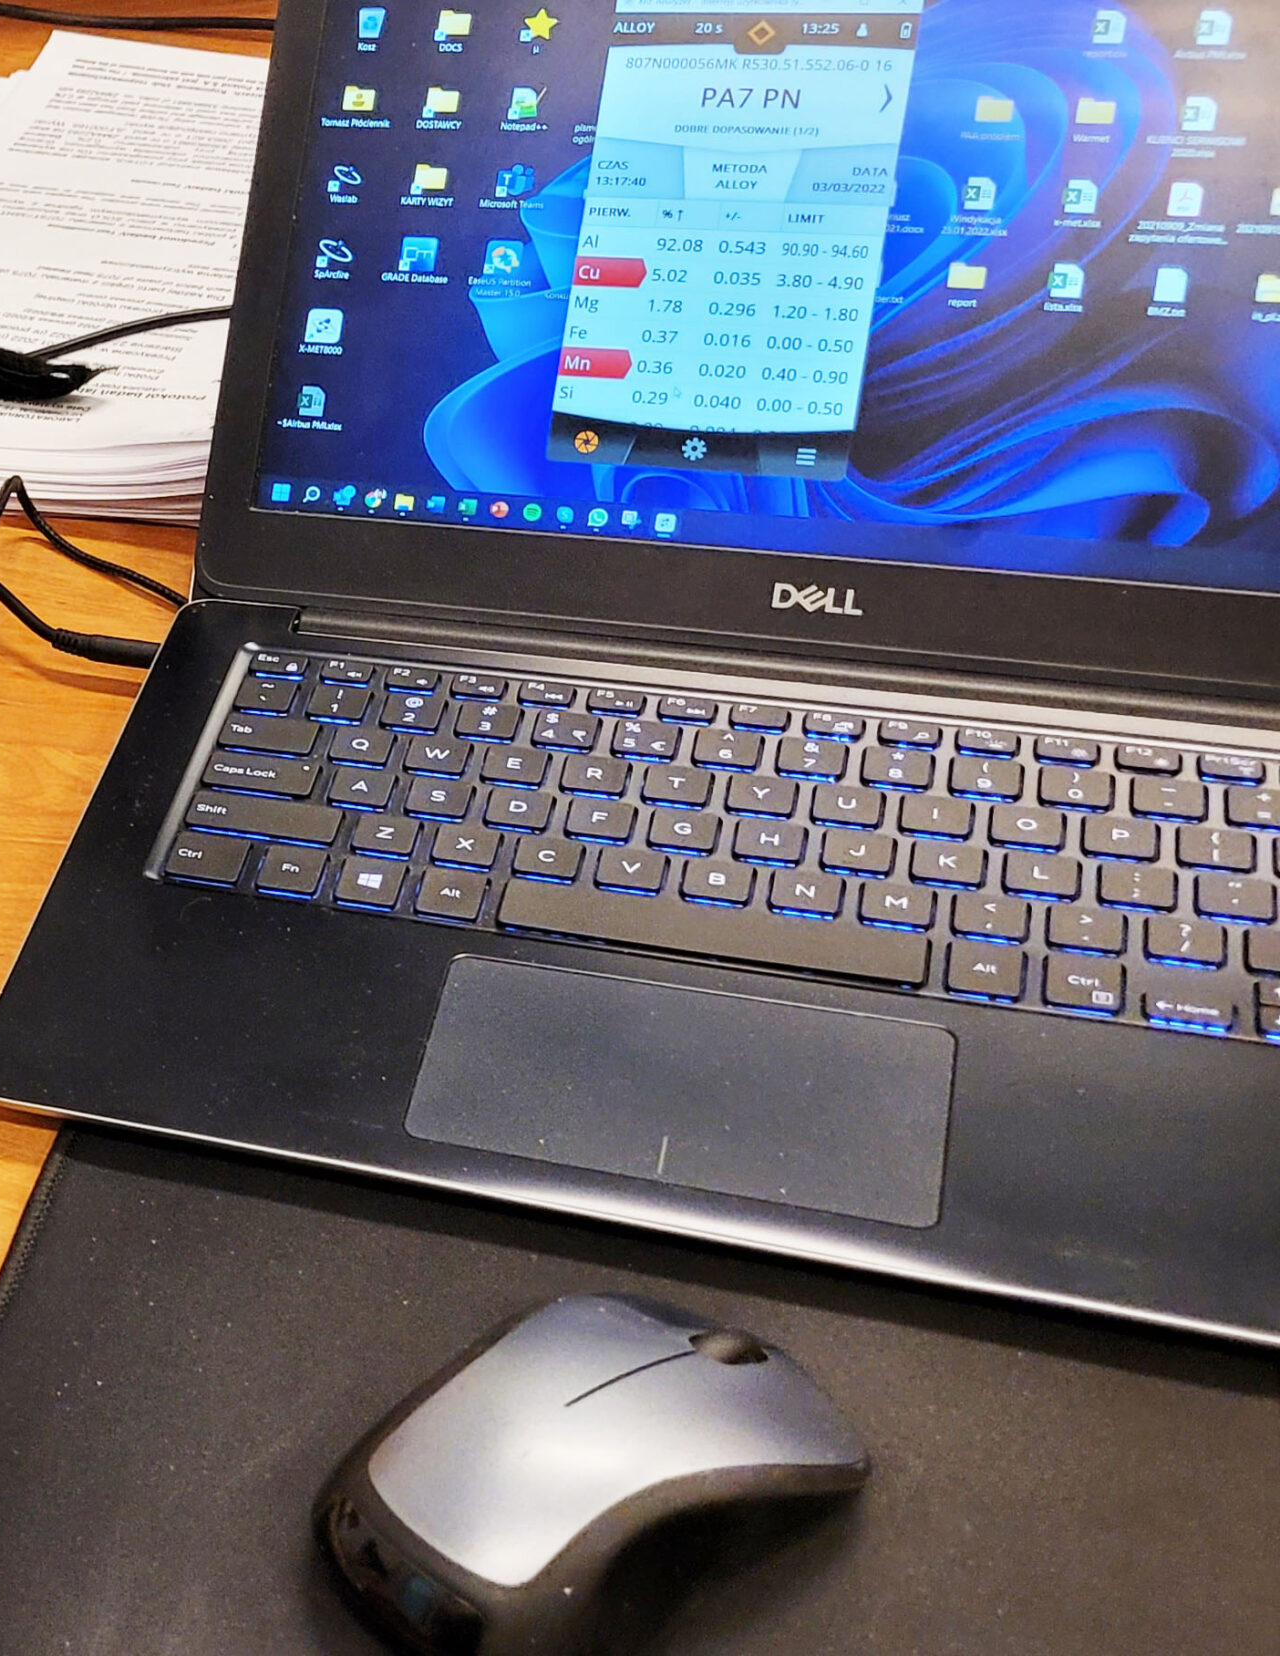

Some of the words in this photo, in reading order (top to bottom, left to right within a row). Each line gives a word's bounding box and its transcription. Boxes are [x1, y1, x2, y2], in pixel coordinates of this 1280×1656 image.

[613, 22, 655, 33] ALLOY
[695, 23, 712, 33] 20
[715, 25, 723, 33] s
[802, 23, 839, 33] 13:25
[358, 42, 377, 52] Kosz
[439, 43, 462, 52] DOCS
[626, 58, 737, 70] 807N000056MK
[876, 61, 892, 71] 16
[701, 88, 754, 108] PA7
[763, 89, 802, 109] PN
[416, 120, 462, 129] DOSTAWCY
[500, 121, 547, 132] Notepad++
[675, 124, 709, 134] DOBRE
[712, 125, 790, 135] DOPASOWANIE
[793, 126, 819, 137] (1/2)
[598, 160, 628, 170] CZAS
[712, 164, 767, 174] METODA
[853, 167, 888, 176] DATA
[596, 176, 646, 186] 13:17:40
[715, 180, 757, 190] ALLOY
[812, 183, 885, 193] 03/03/2022
[401, 197, 427, 207] KARTY
[428, 198, 454, 208] WIZYT
[480, 199, 517, 209] Microsoft
[520, 201, 544, 210] Teams
[589, 207, 630, 217] PIERW.
[788, 214, 824, 224] LIMIT
[582, 235, 599, 248] Al
[656, 239, 703, 252] 92.08
[719, 241, 766, 254] 0.543
[782, 243, 819, 257] 90.90
[831, 245, 868, 259] 94.60
[382, 273, 410, 283] GRADE
[411, 274, 448, 284] Database
[579, 265, 600, 279] Cu
[651, 270, 688, 283] 5.02
[713, 271, 761, 285] 0.035
[776, 274, 812, 288] 3.80
[828, 276, 863, 290] 4.90
[574, 296, 599, 313] Mg
[649, 300, 683, 313] 1.78
[709, 303, 756, 316] 0.296
[774, 305, 807, 319] 1.20
[826, 308, 858, 321] 1.80
[948, 299, 977, 308] report
[570, 326, 587, 339] Fe
[642, 330, 678, 343] 0.37
[704, 334, 751, 347] 0.016
[767, 337, 802, 350] 0.00
[818, 338, 854, 353] 0.50
[564, 356, 590, 371] Mn
[637, 361, 672, 374] 0.36
[699, 365, 745, 378] 0.020
[762, 368, 797, 381] 0.40
[813, 370, 848, 384] 0.90
[560, 386, 573, 399] Si
[632, 391, 668, 404] 0.29
[694, 395, 741, 409] 0.040
[757, 398, 791, 413] 0.00
[808, 401, 843, 416] 0.50
[771, 583, 863, 616] DELL
[258, 655, 280, 663] Esc
[394, 667, 411, 676] F2
[459, 674, 476, 684] F3
[528, 681, 545, 691] F4
[403, 713, 415, 723] 2
[231, 724, 252, 734] Tab
[479, 721, 491, 731] 3
[541, 729, 555, 739] 4
[352, 739, 367, 751] Q
[623, 738, 634, 747] 5
[425, 747, 450, 760] W
[719, 749, 732, 759] 6
[507, 758, 521, 769] E
[804, 758, 816, 768] 7
[214, 763, 244, 778] Caps
[246, 767, 276, 779] Lock
[587, 767, 603, 780] R
[889, 768, 902, 778] 8
[352, 781, 368, 792] A
[669, 777, 685, 788] T
[977, 778, 990, 787] 9
[431, 790, 445, 802] S
[752, 787, 771, 798] Y
[510, 801, 526, 813] D
[838, 797, 856, 809] U
[196, 803, 227, 816] Shift
[593, 812, 608, 823] F
[675, 822, 691, 835] G
[1017, 817, 1036, 831] O
[377, 827, 392, 838] Z
[1112, 829, 1129, 841] P
[456, 837, 475, 850] X
[761, 832, 779, 845] H
[178, 848, 202, 859] Ctrl
[539, 850, 555, 862] C
[850, 845, 865, 856] J
[938, 854, 956, 867] K
[281, 863, 299, 873] Fn
[622, 861, 641, 874] V
[1033, 867, 1048, 879] L
[709, 873, 724, 885] B
[441, 886, 460, 898] Alt
[796, 884, 815, 898] N
[885, 895, 908, 908] M
[973, 961, 996, 975] Alt
[1068, 973, 1100, 987] Ctrl
